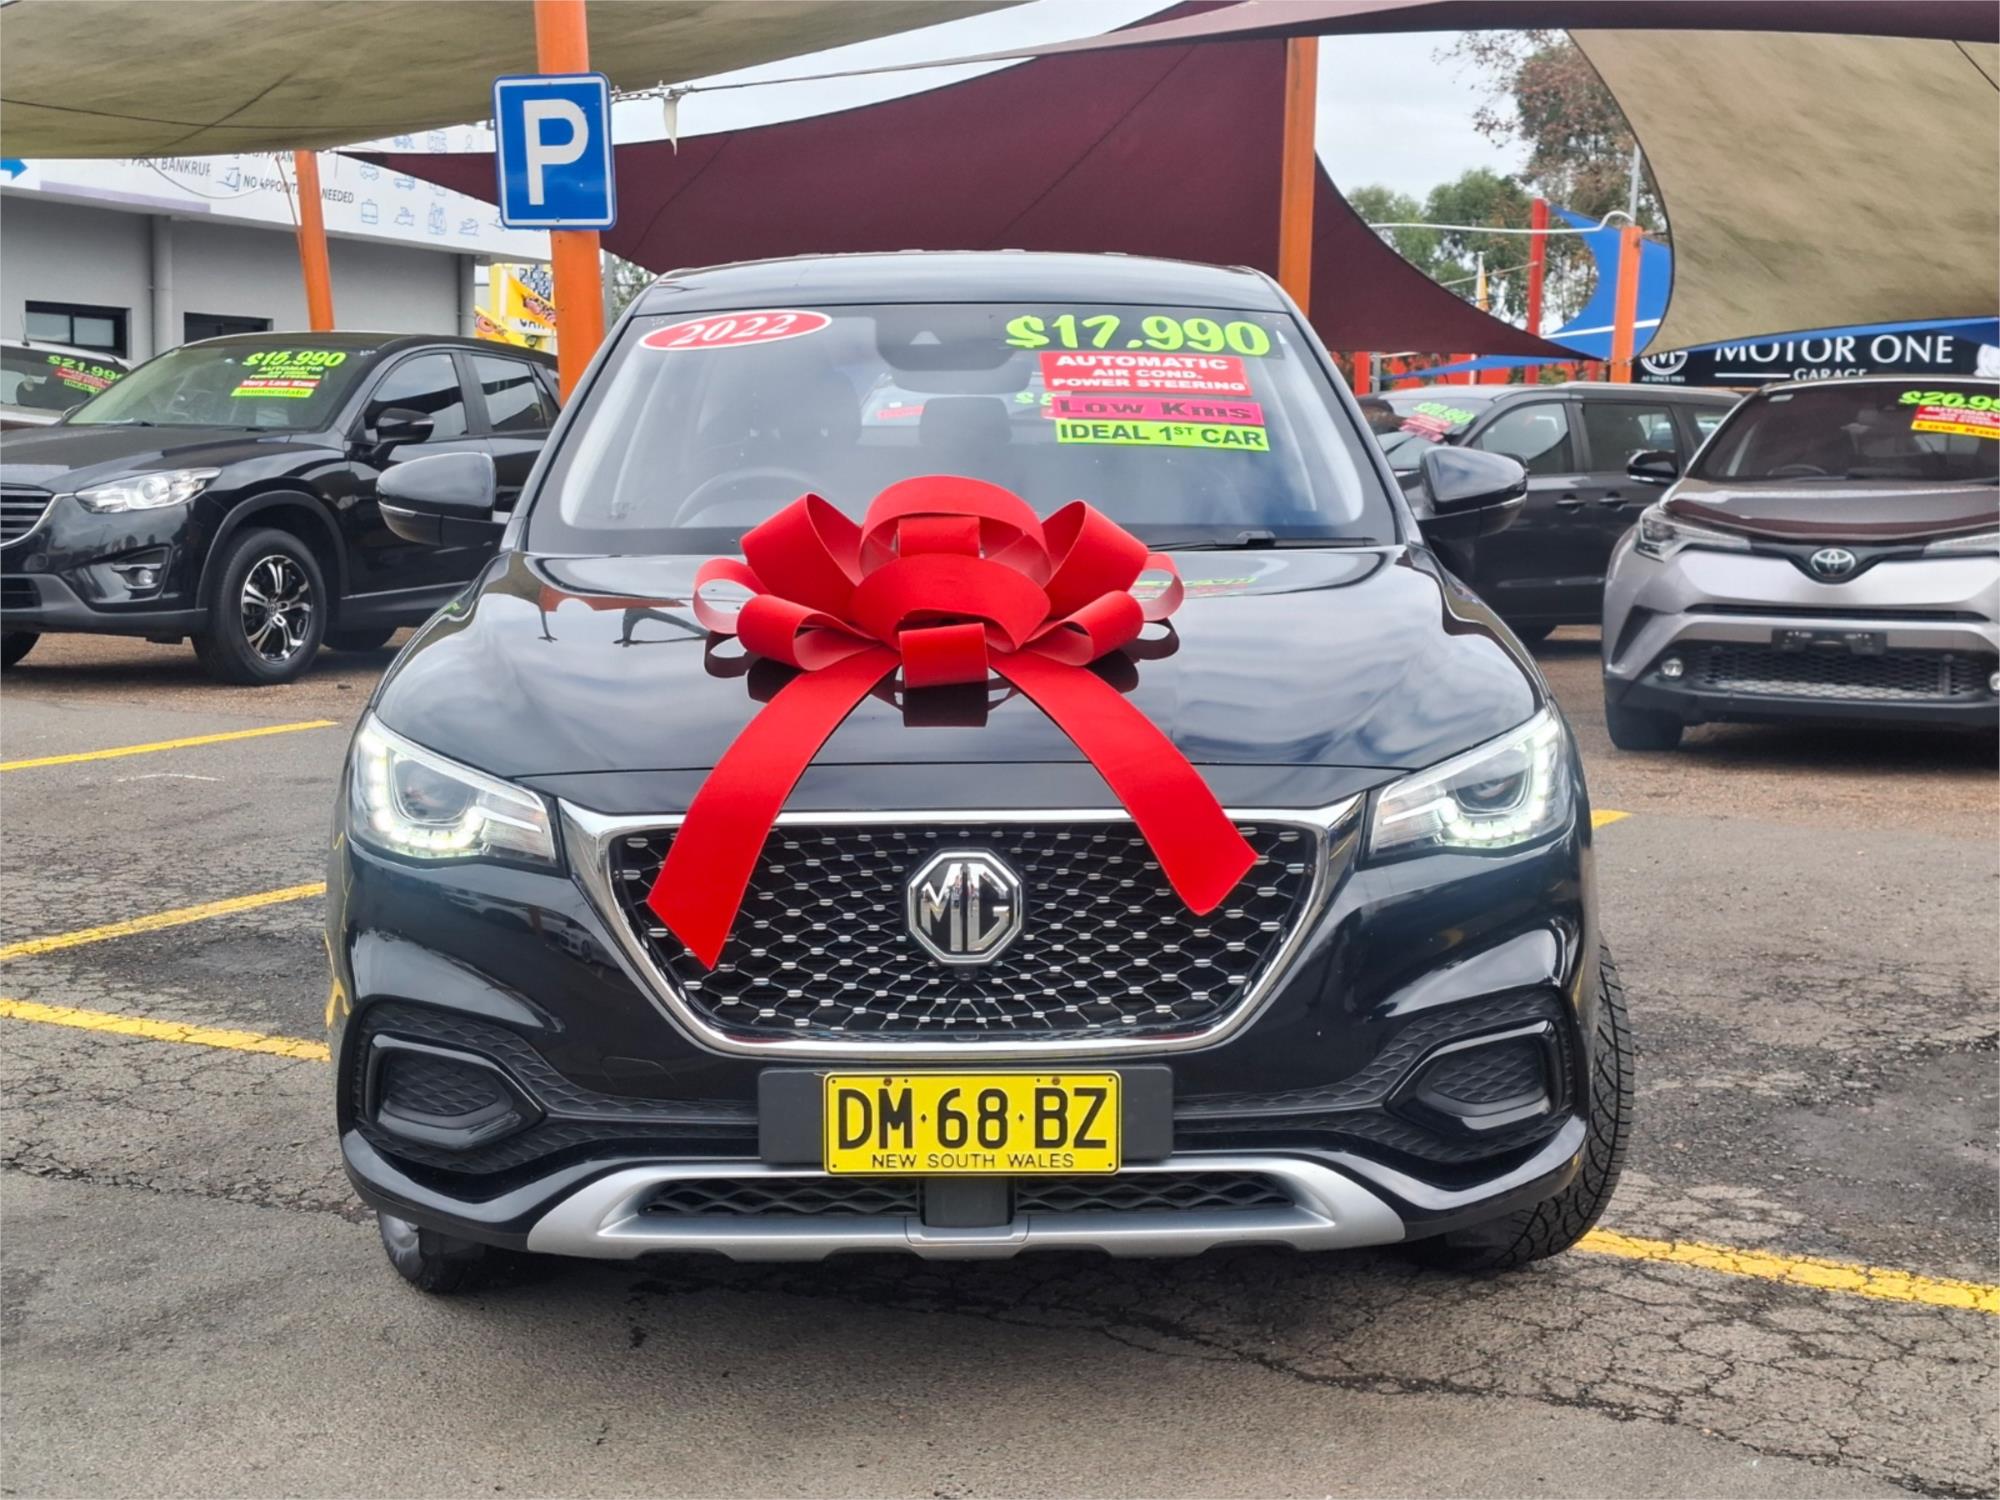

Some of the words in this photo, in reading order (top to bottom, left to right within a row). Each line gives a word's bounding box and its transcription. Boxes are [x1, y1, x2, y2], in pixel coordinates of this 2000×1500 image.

[523, 98, 590, 206] P
[243, 175, 257, 188] NO
[322, 188, 355, 203] NEEDED
[667, 314, 798, 347] 2022
[1005, 314, 1271, 356] $17.990
[1715, 335, 1856, 363] MOTOR
[1871, 334, 1954, 363] ONE
[1056, 355, 1229, 371] AUTOMATIC
[1092, 368, 1131, 377] AIR
[1136, 369, 1203, 379] COND.
[1052, 378, 1132, 388] POWER
[1135, 379, 1246, 391] STEERING
[1059, 399, 1144, 414] Low
[1060, 423, 1150, 441] IDEAL
[1201, 428, 1264, 446] CAR
[919, 860, 1011, 954] MG
[872, 1152, 917, 1169] NEW
[927, 1152, 995, 1169] SOUTH
[1007, 1152, 1075, 1169] WALES
